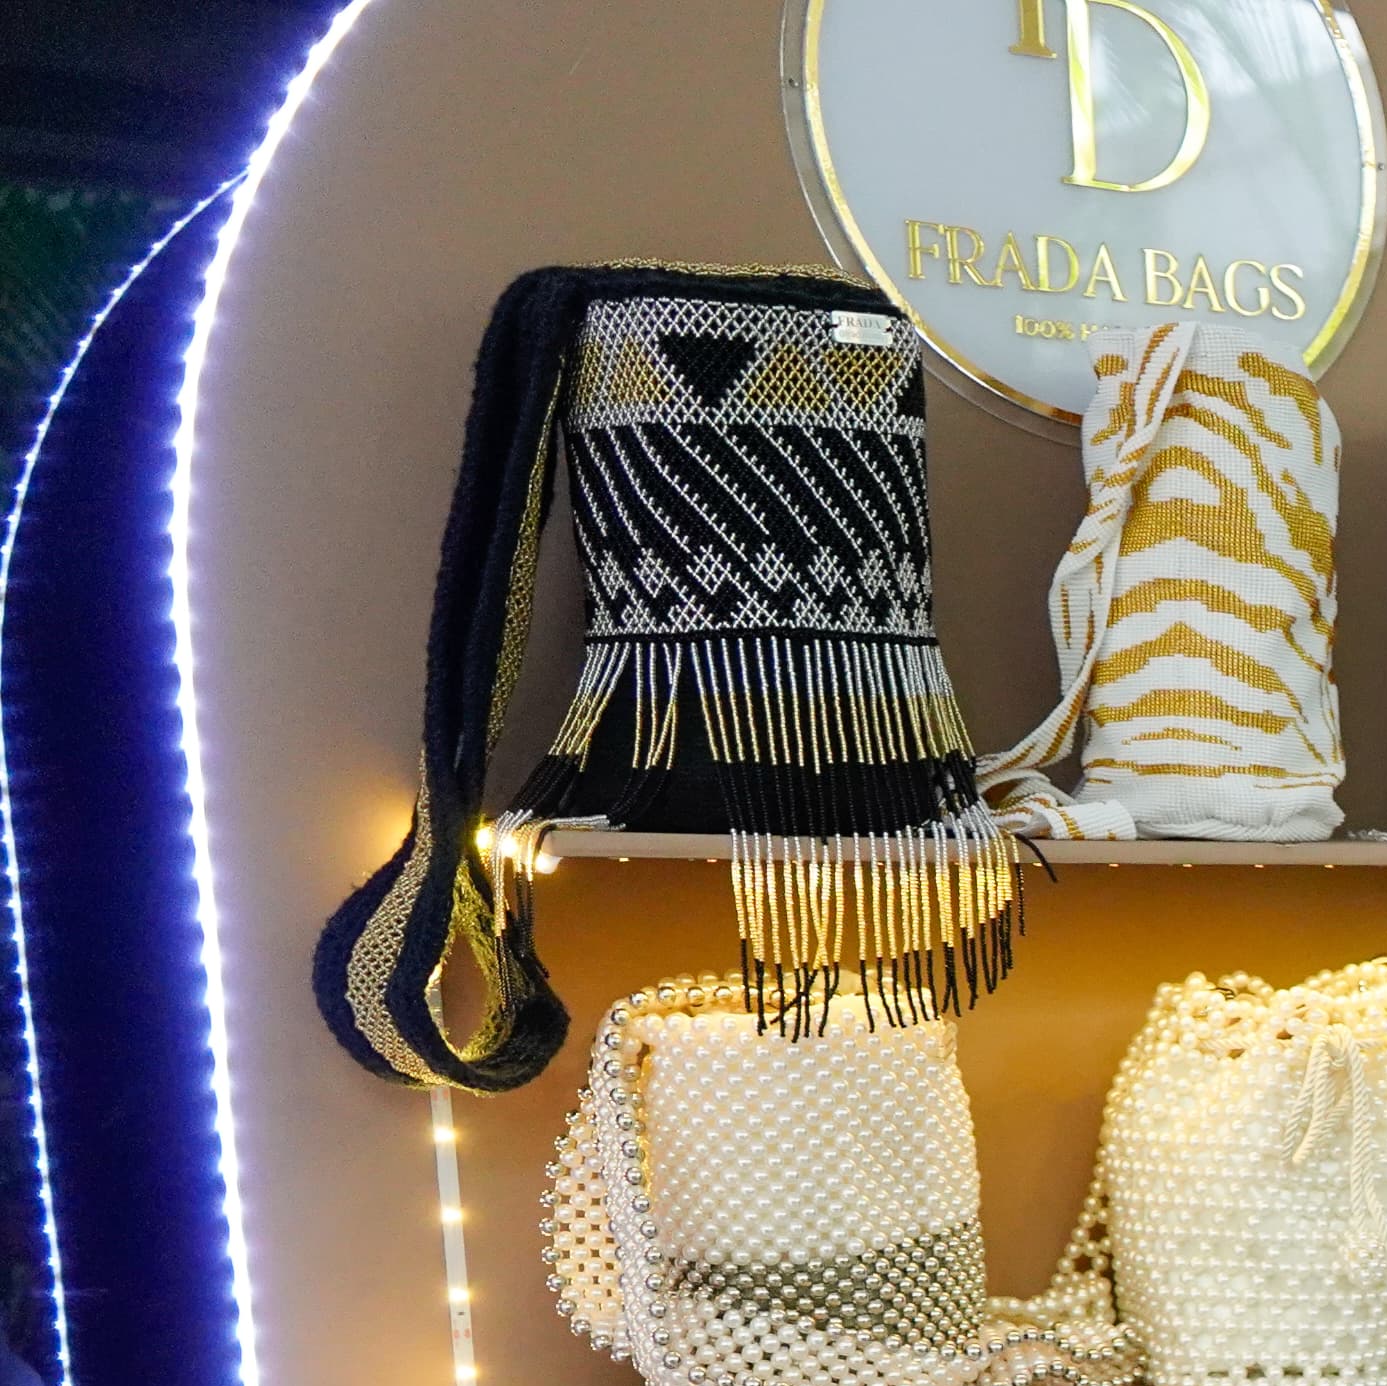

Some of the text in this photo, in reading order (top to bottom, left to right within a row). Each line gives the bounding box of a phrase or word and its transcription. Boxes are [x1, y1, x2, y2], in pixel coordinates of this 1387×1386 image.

[904, 218, 1306, 320] FRADA BAGS
[1015, 314, 1075, 340] 100%
